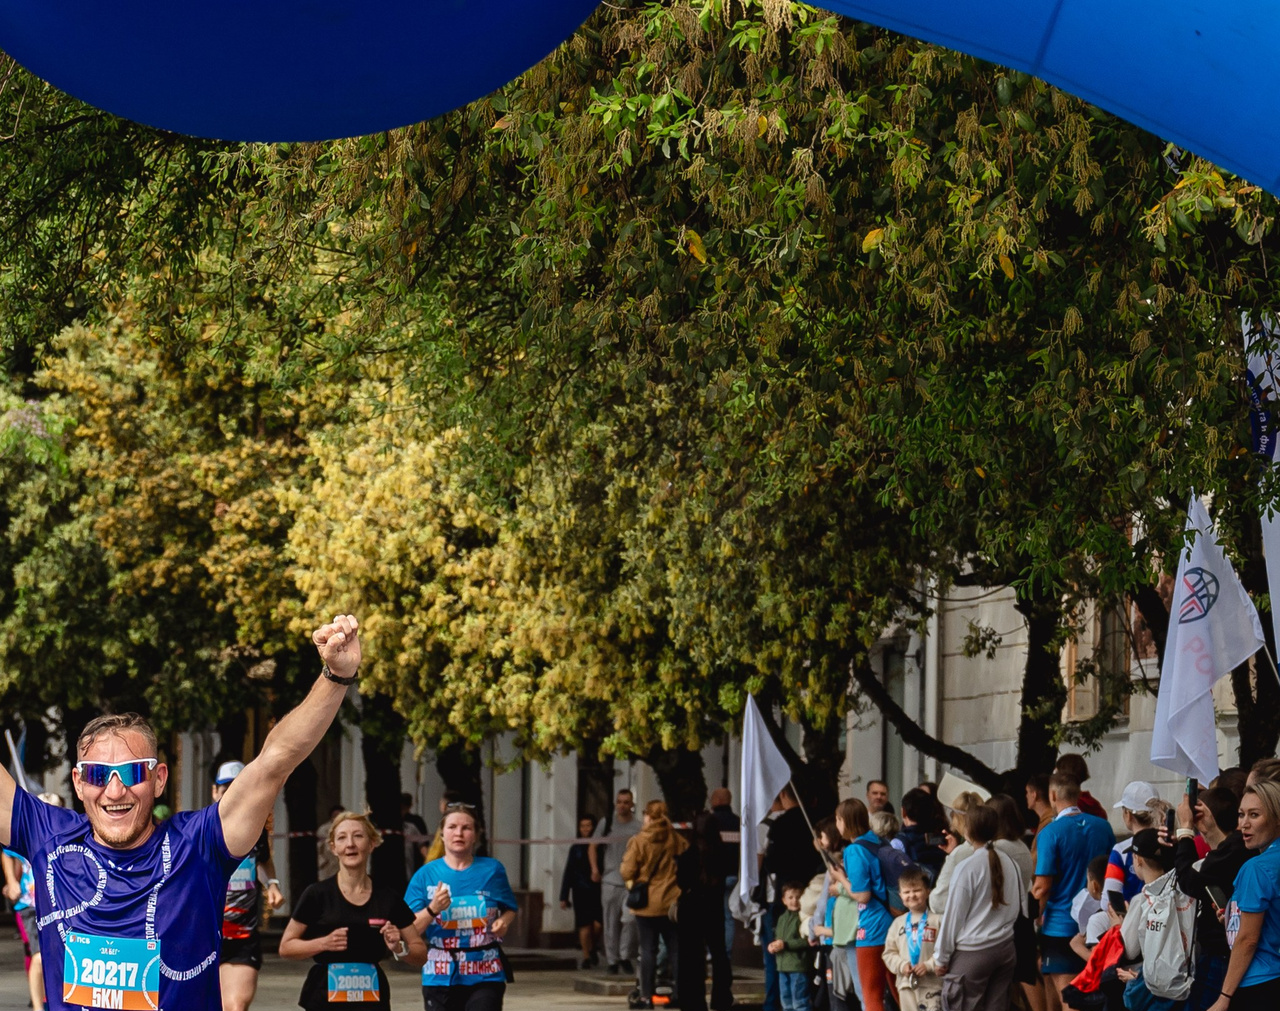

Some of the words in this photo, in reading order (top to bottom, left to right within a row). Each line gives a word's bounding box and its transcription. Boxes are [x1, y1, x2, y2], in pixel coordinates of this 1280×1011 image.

[81, 958, 138, 988] 20217
[338, 975, 371, 990] 20083
[92, 986, 124, 1010] 5KM
